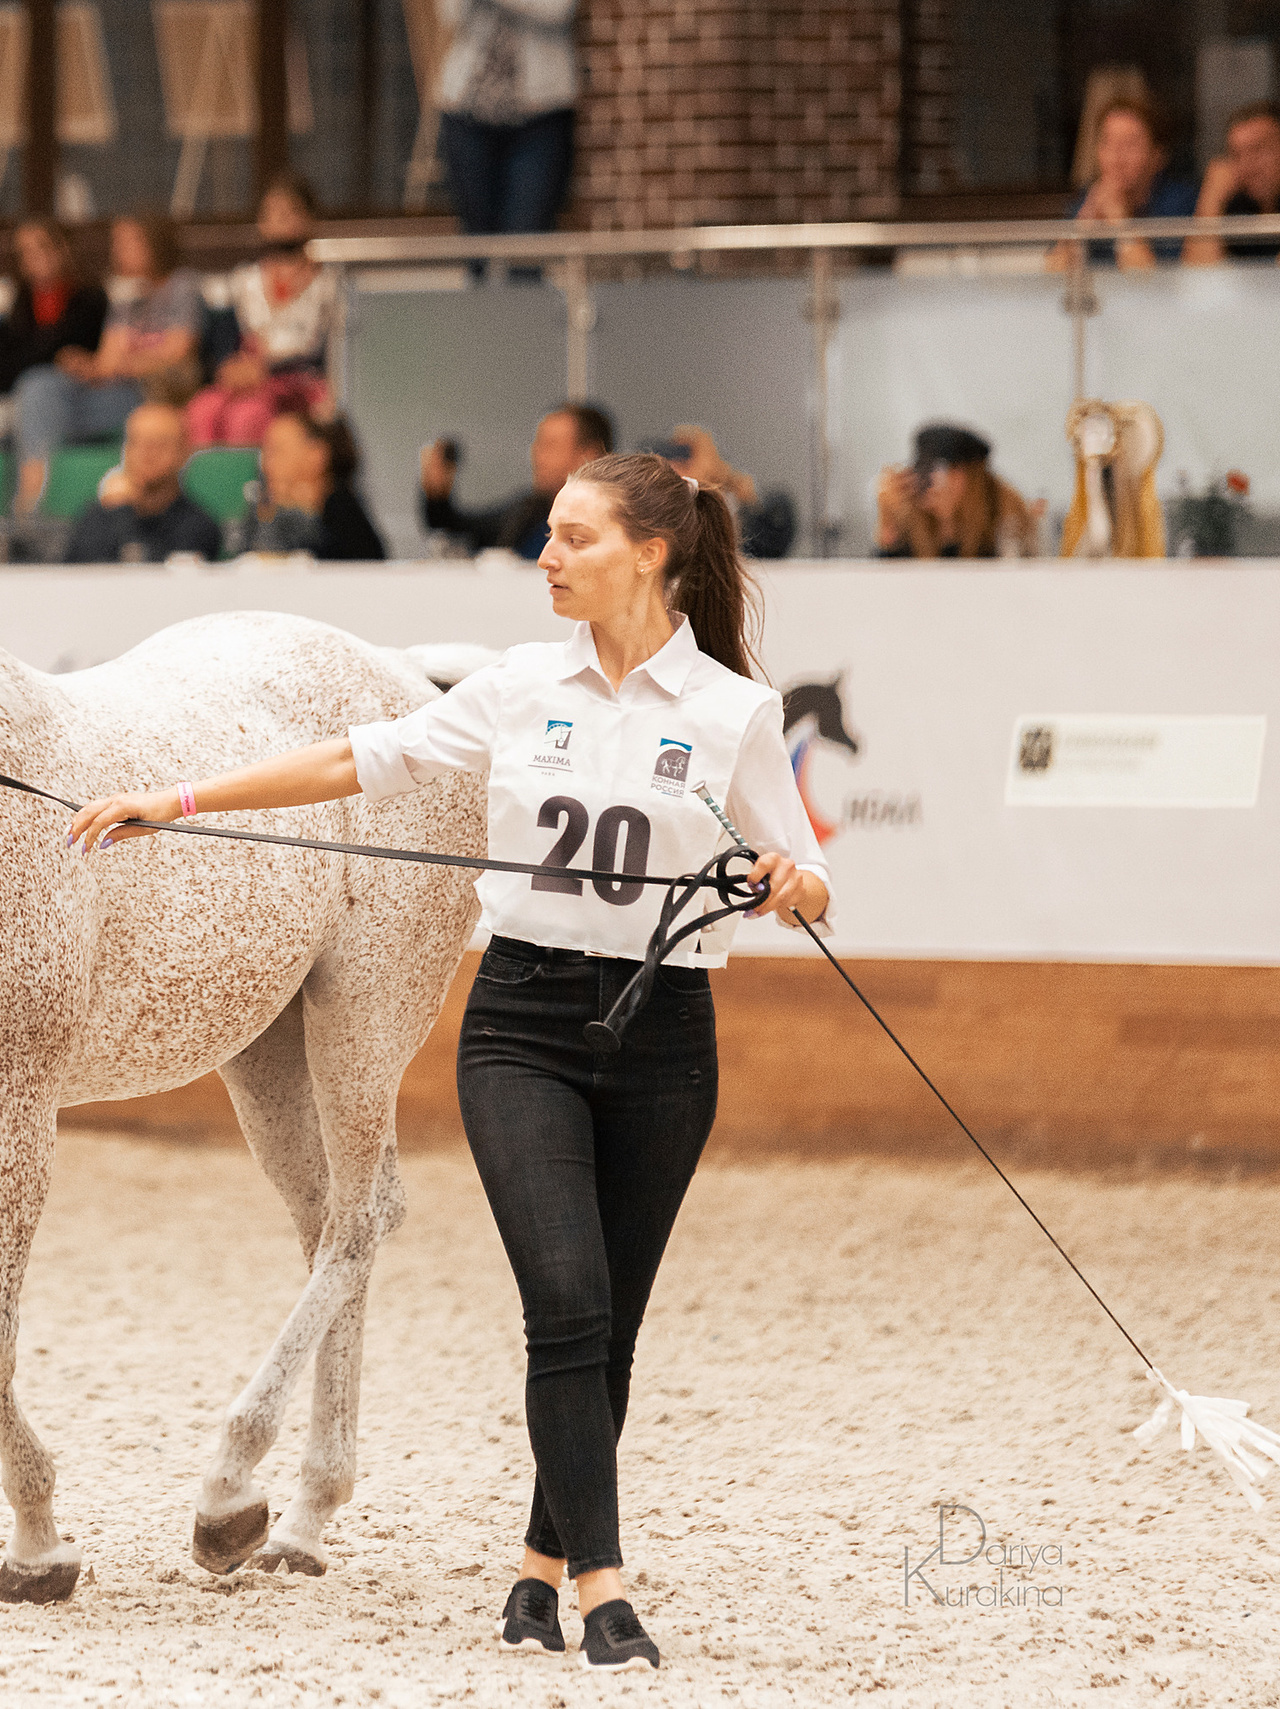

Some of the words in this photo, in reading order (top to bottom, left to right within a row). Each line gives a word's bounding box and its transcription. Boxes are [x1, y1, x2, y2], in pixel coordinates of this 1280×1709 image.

[533, 755, 571, 766] MAXIMA
[652, 775, 686, 789] КОННАЯ
[650, 783, 685, 796] РОССИЯ
[531, 795, 651, 906] 20
